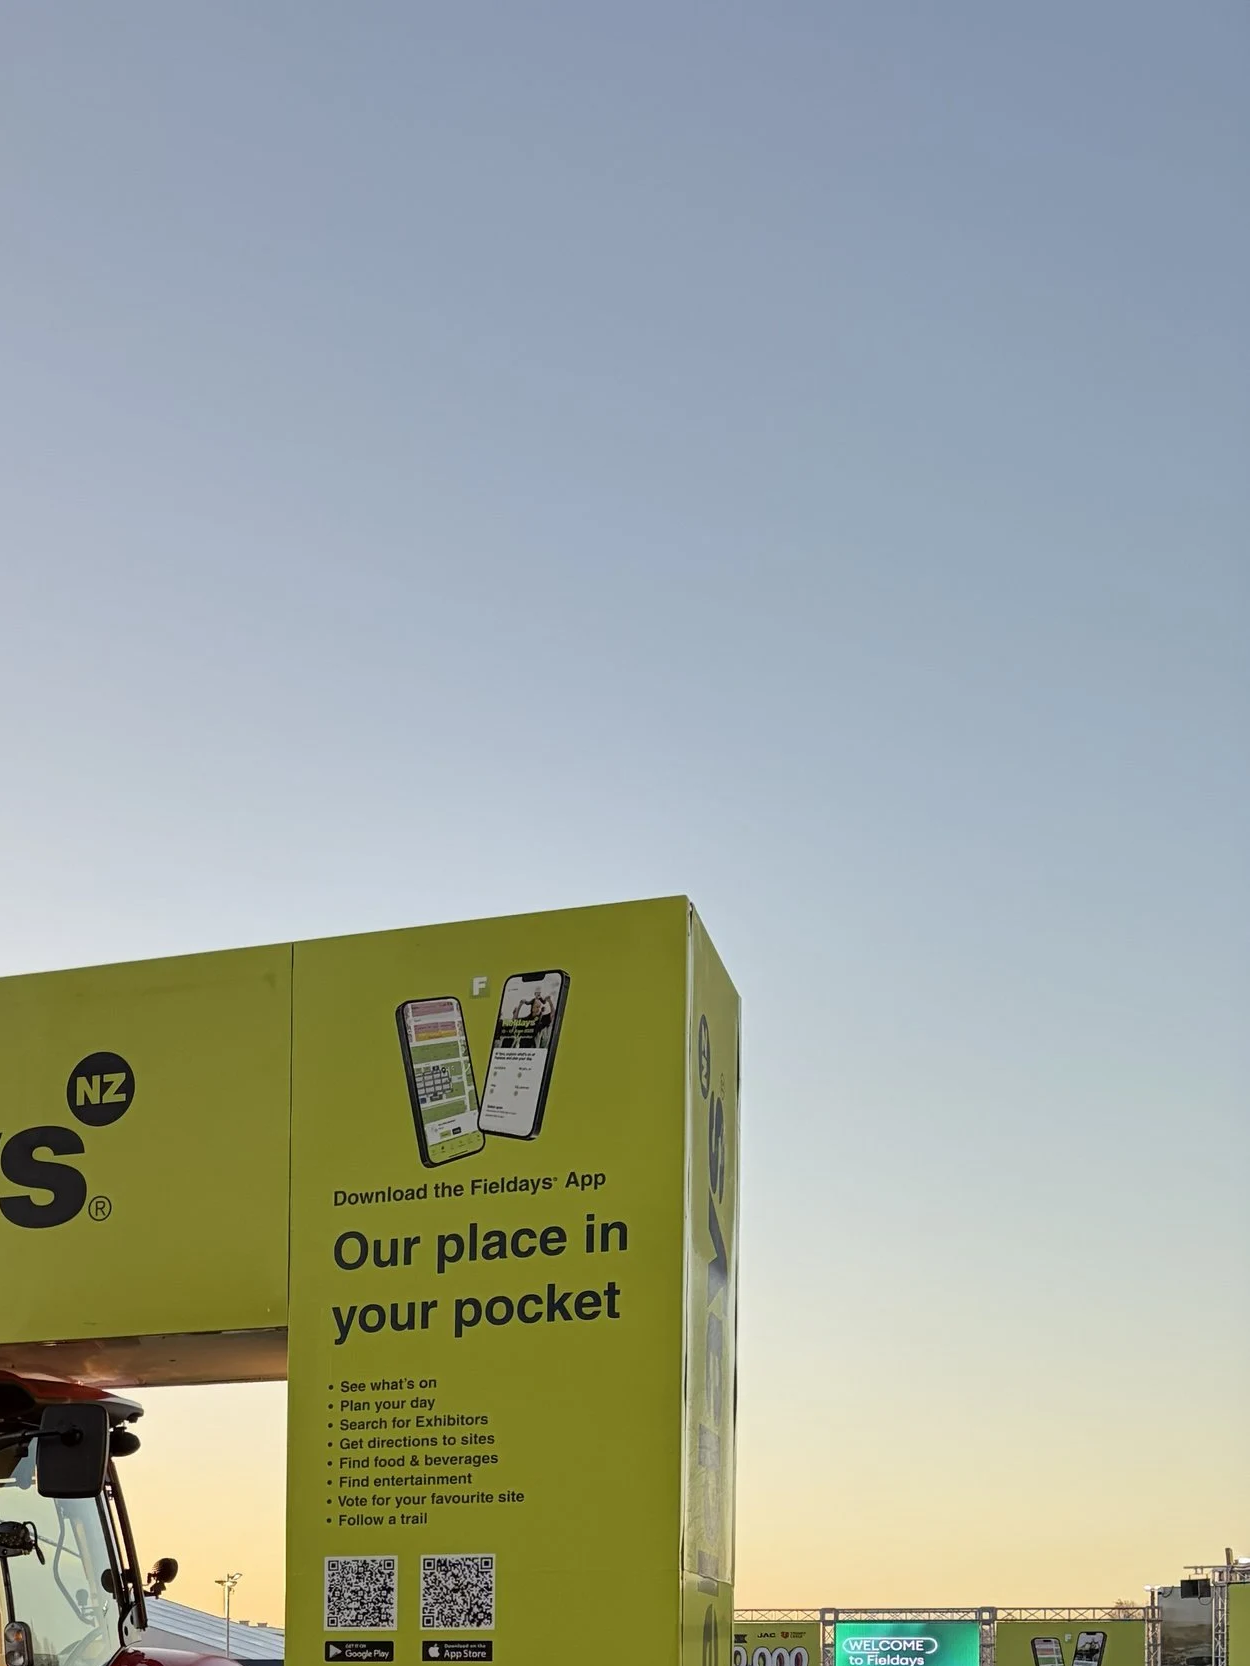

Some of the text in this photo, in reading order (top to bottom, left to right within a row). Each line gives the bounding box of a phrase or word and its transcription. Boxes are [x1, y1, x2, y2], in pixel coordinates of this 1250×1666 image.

[75, 1072, 127, 1107] NZ
[333, 1181, 428, 1207] Download
[433, 1182, 464, 1198] the
[565, 1170, 606, 1191] App
[333, 1213, 628, 1274] Our place in
[332, 1281, 621, 1346] your pocket
[340, 1378, 437, 1393] See what's on
[340, 1397, 436, 1413] Plan your day
[340, 1414, 489, 1431] Search for Exhibitors
[339, 1433, 495, 1450] Get directions to sites
[339, 1453, 499, 1469] Find food & beverages
[339, 1472, 473, 1488] Find entertainment
[338, 1490, 525, 1508] Vote for your favourite site
[338, 1512, 428, 1527] Follow a trail
[849, 1640, 924, 1651] WELCOME
[345, 1650, 390, 1660] Google Play
[444, 1650, 487, 1660] App Store
[849, 1655, 864, 1666] to
